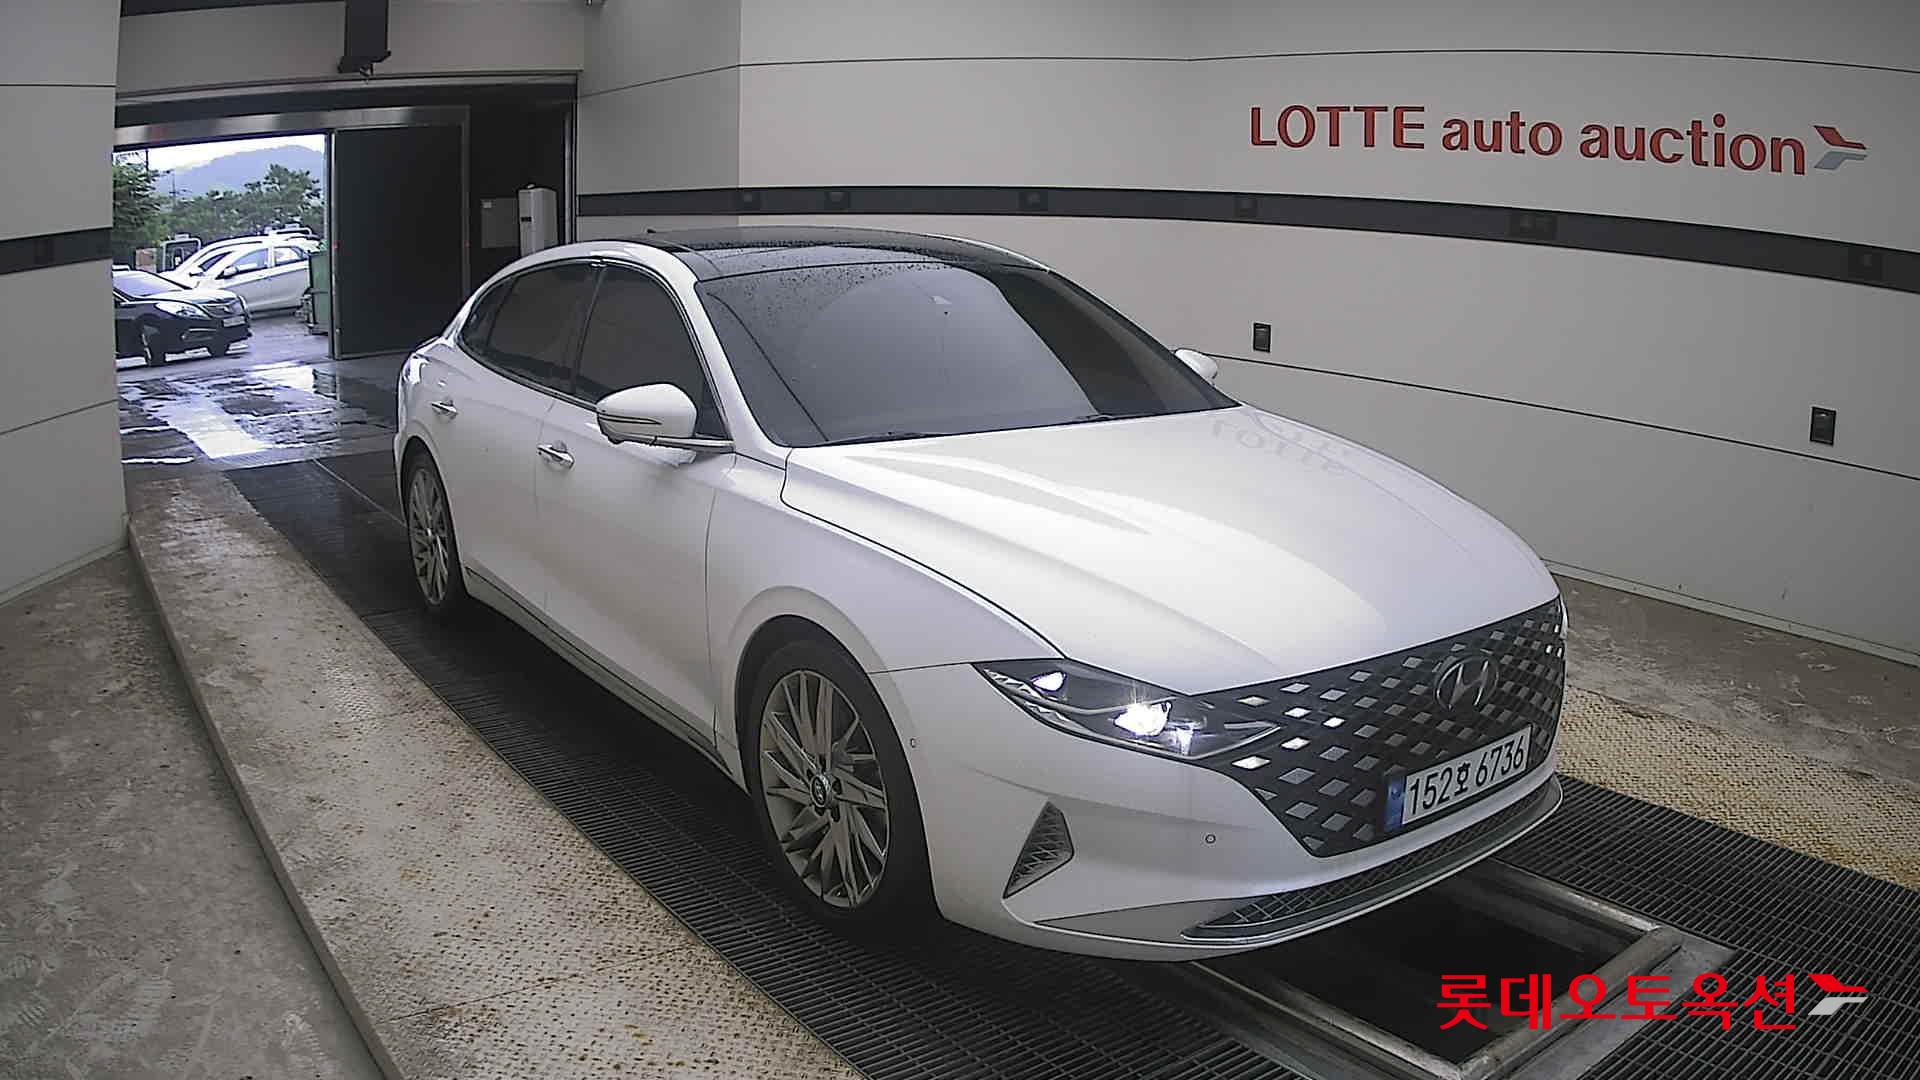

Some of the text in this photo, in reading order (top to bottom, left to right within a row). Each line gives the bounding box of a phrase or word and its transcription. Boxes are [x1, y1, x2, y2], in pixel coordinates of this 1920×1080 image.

[1251, 105, 1806, 175] LOTTE auto auction
[1475, 735, 1525, 787] 6736
